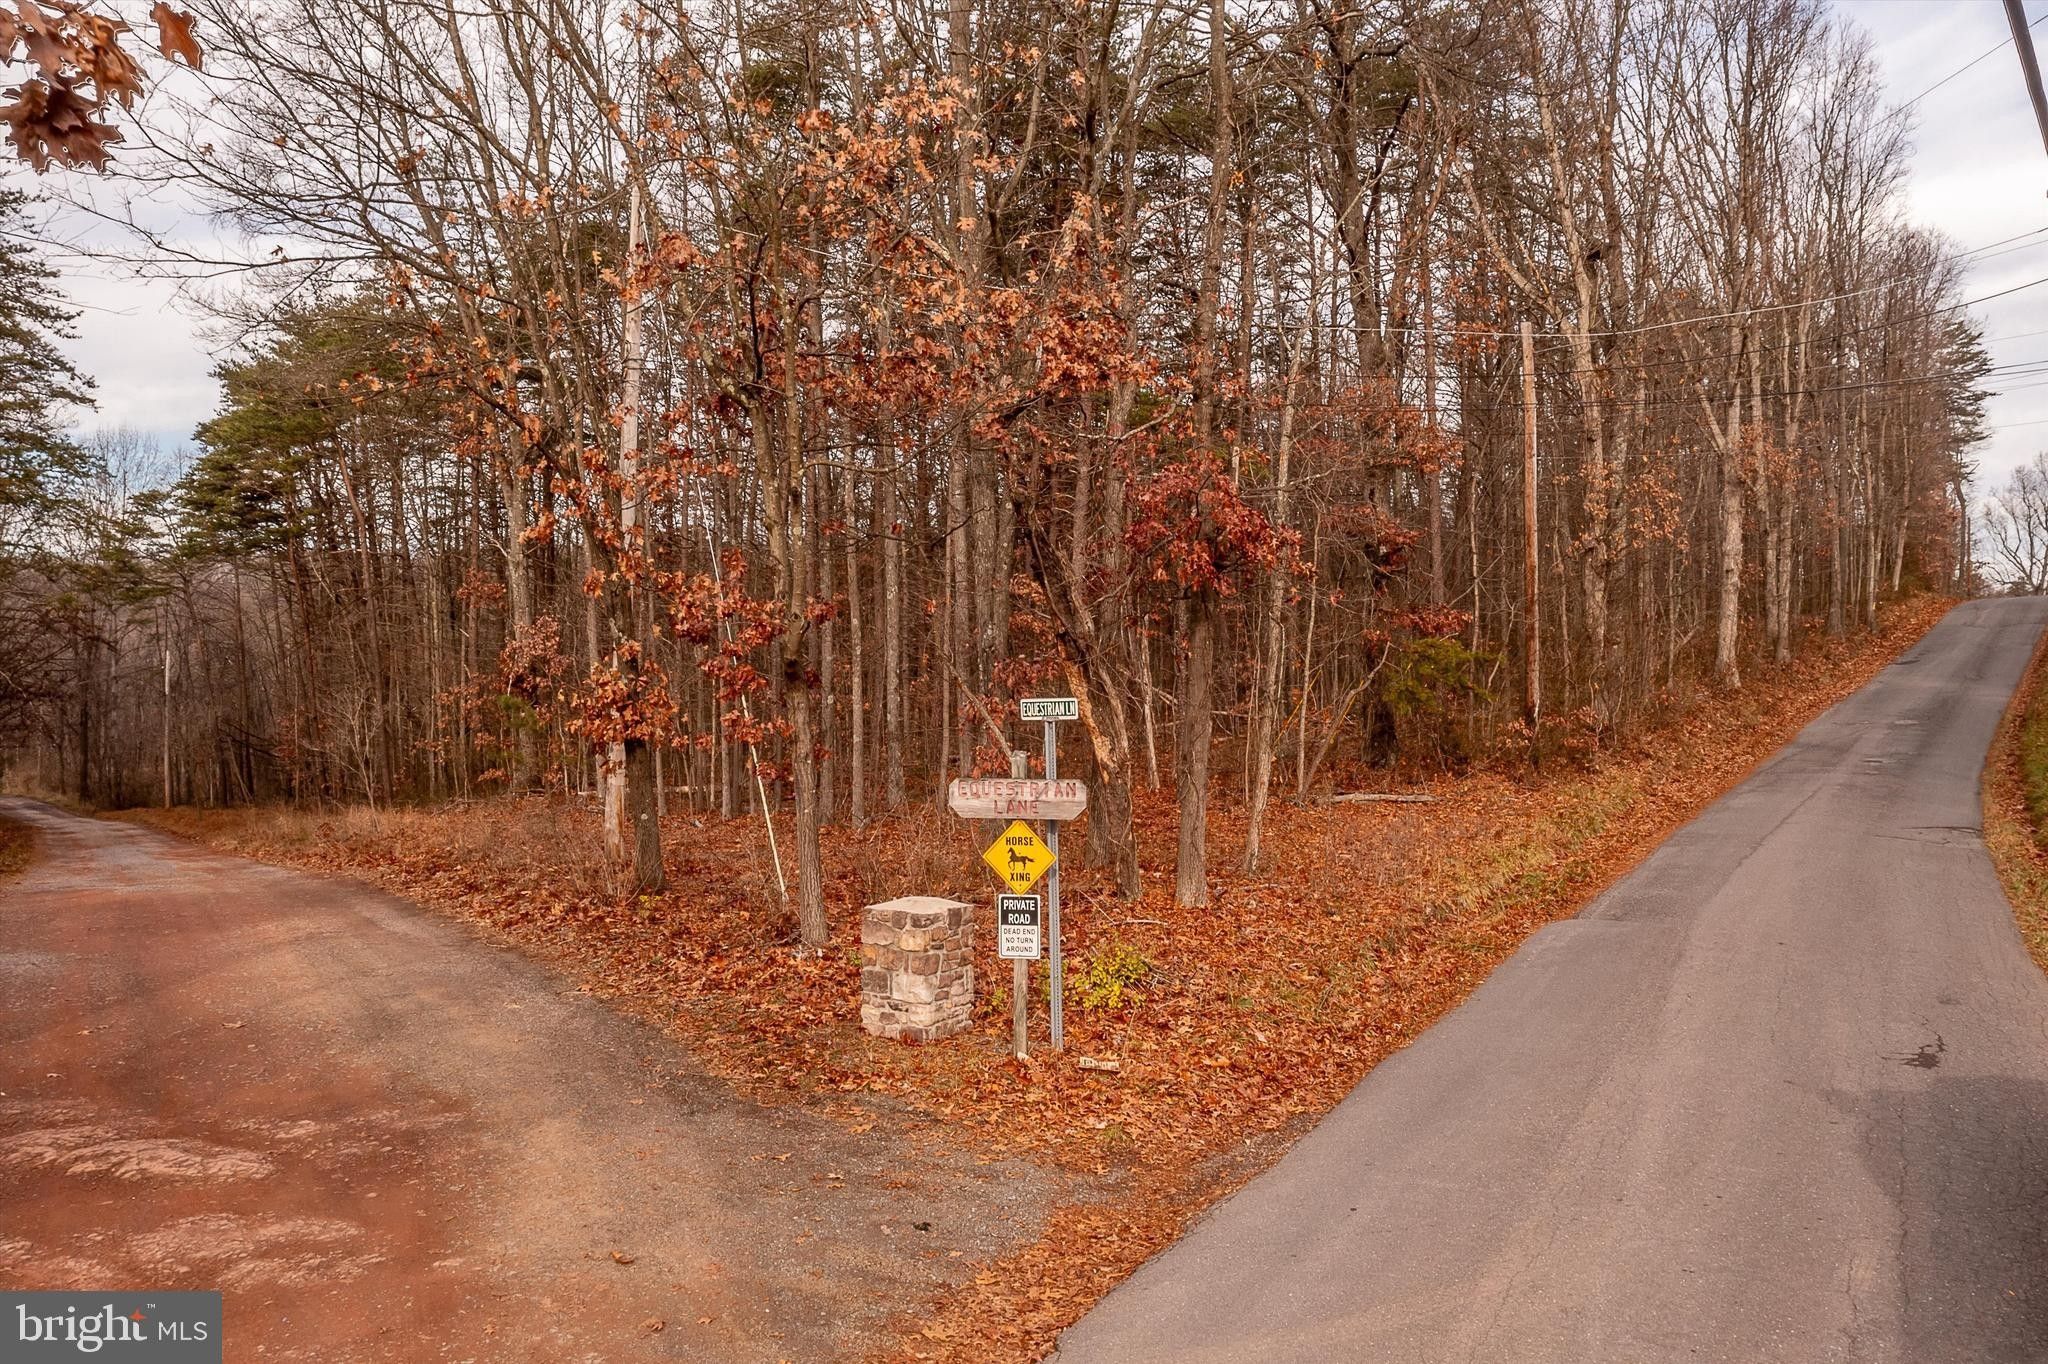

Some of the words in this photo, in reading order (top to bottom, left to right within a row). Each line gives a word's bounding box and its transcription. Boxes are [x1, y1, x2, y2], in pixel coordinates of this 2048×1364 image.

[1022, 702, 1065, 717] EQUESTRIAN
[1065, 701, 1075, 715] LN
[957, 780, 1077, 799] EQUESTRIAN
[994, 799, 1040, 815] LANE
[1005, 836, 1034, 846] HORSE
[1009, 872, 1031, 882] XING
[1003, 899, 1036, 911] PRIVATE
[1008, 913, 1031, 925] ROAD
[1006, 945, 1034, 953] AROUND
